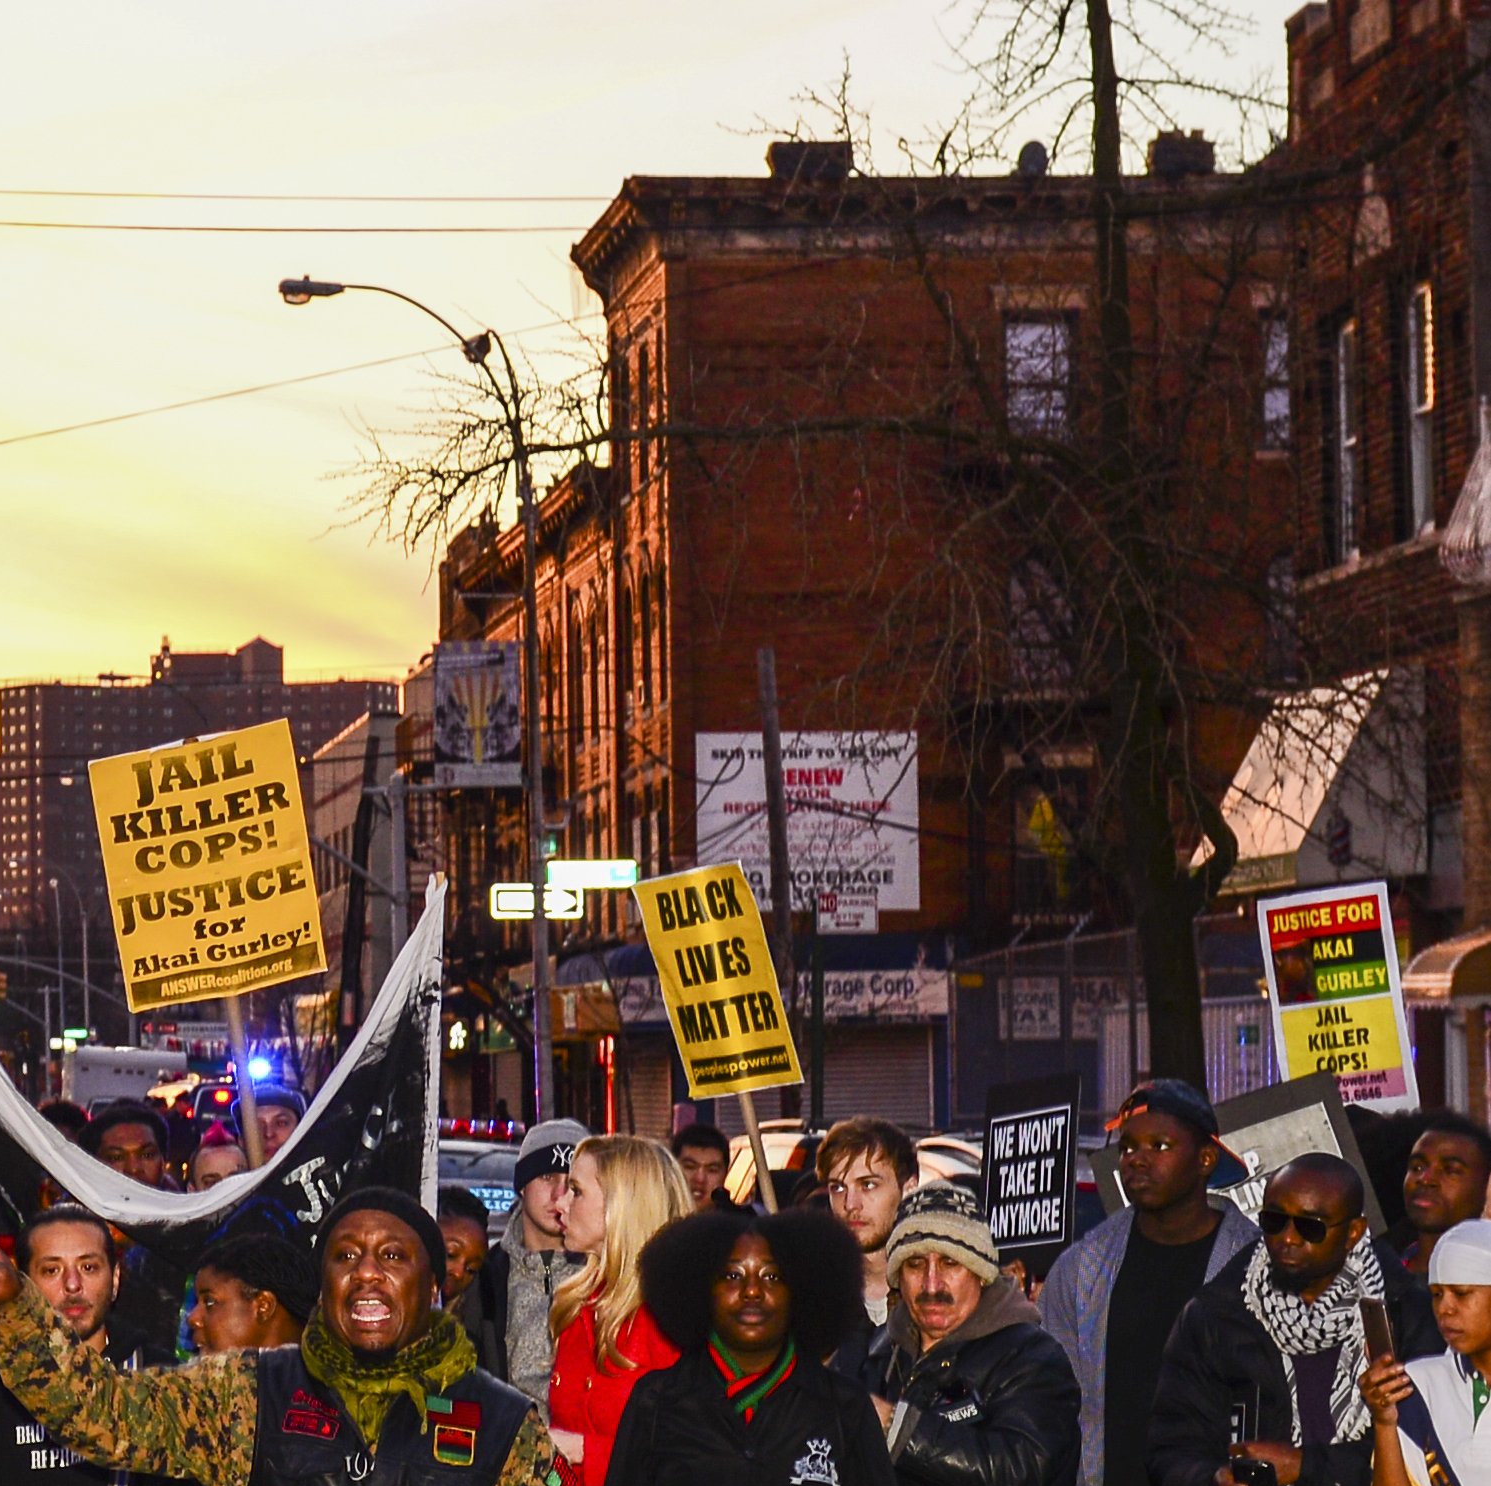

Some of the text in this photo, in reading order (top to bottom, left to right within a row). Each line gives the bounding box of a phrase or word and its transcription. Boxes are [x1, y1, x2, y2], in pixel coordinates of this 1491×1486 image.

[132, 741, 254, 807] JAIL
[781, 768, 844, 787] ENEW
[110, 781, 290, 844] KILLER
[135, 820, 278, 874] COPS!
[117, 860, 306, 936] JUSTICE
[656, 877, 744, 932] BLACK
[819, 894, 836, 912] NO
[194, 916, 246, 939] for
[1272, 902, 1374, 933] JUSTICE FOR
[132, 921, 311, 978] Akai Gurley!
[674, 937, 751, 988] LIVES
[1313, 938, 1354, 961] AKAI
[160, 958, 293, 997] ANSWERcoalition.org
[1317, 967, 1387, 992] GURLEY
[676, 991, 779, 1045] MATTER
[1315, 1006, 1353, 1028] JAIL
[1308, 1028, 1370, 1052] KILLER
[693, 1050, 789, 1078] peoplespower.net
[1316, 1052, 1368, 1073] COPS!
[994, 1116, 1066, 1161] WE WON'T
[469, 1188, 515, 1199] NYPD
[999, 1158, 1056, 1199] TAKE IT
[990, 1197, 1061, 1239] ANYMORE
[947, 1407, 979, 1423] NEWS
